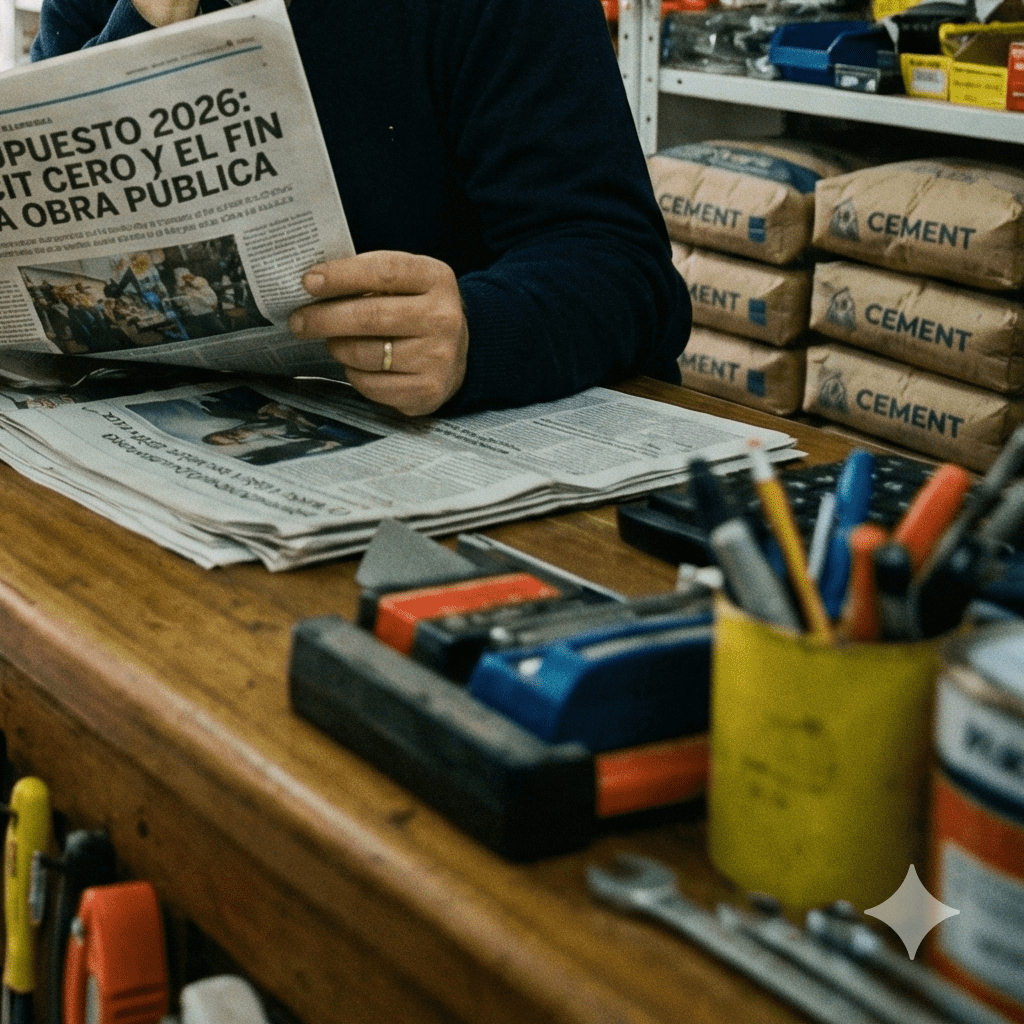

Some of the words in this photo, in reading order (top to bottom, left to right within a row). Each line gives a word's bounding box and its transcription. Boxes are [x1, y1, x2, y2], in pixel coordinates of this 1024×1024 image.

[148, 87, 251, 138] 2026:
[42, 153, 136, 193] CERO
[140, 144, 163, 175] Y
[174, 134, 219, 167] EL
[223, 111, 284, 153] FIN
[22, 191, 120, 228] OBRA
[659, 192, 742, 229] CEMENT
[866, 210, 977, 250] CEMENT
[864, 302, 974, 353] CEMENT
[680, 352, 741, 383] MENT
[856, 388, 965, 439] CEMENT
